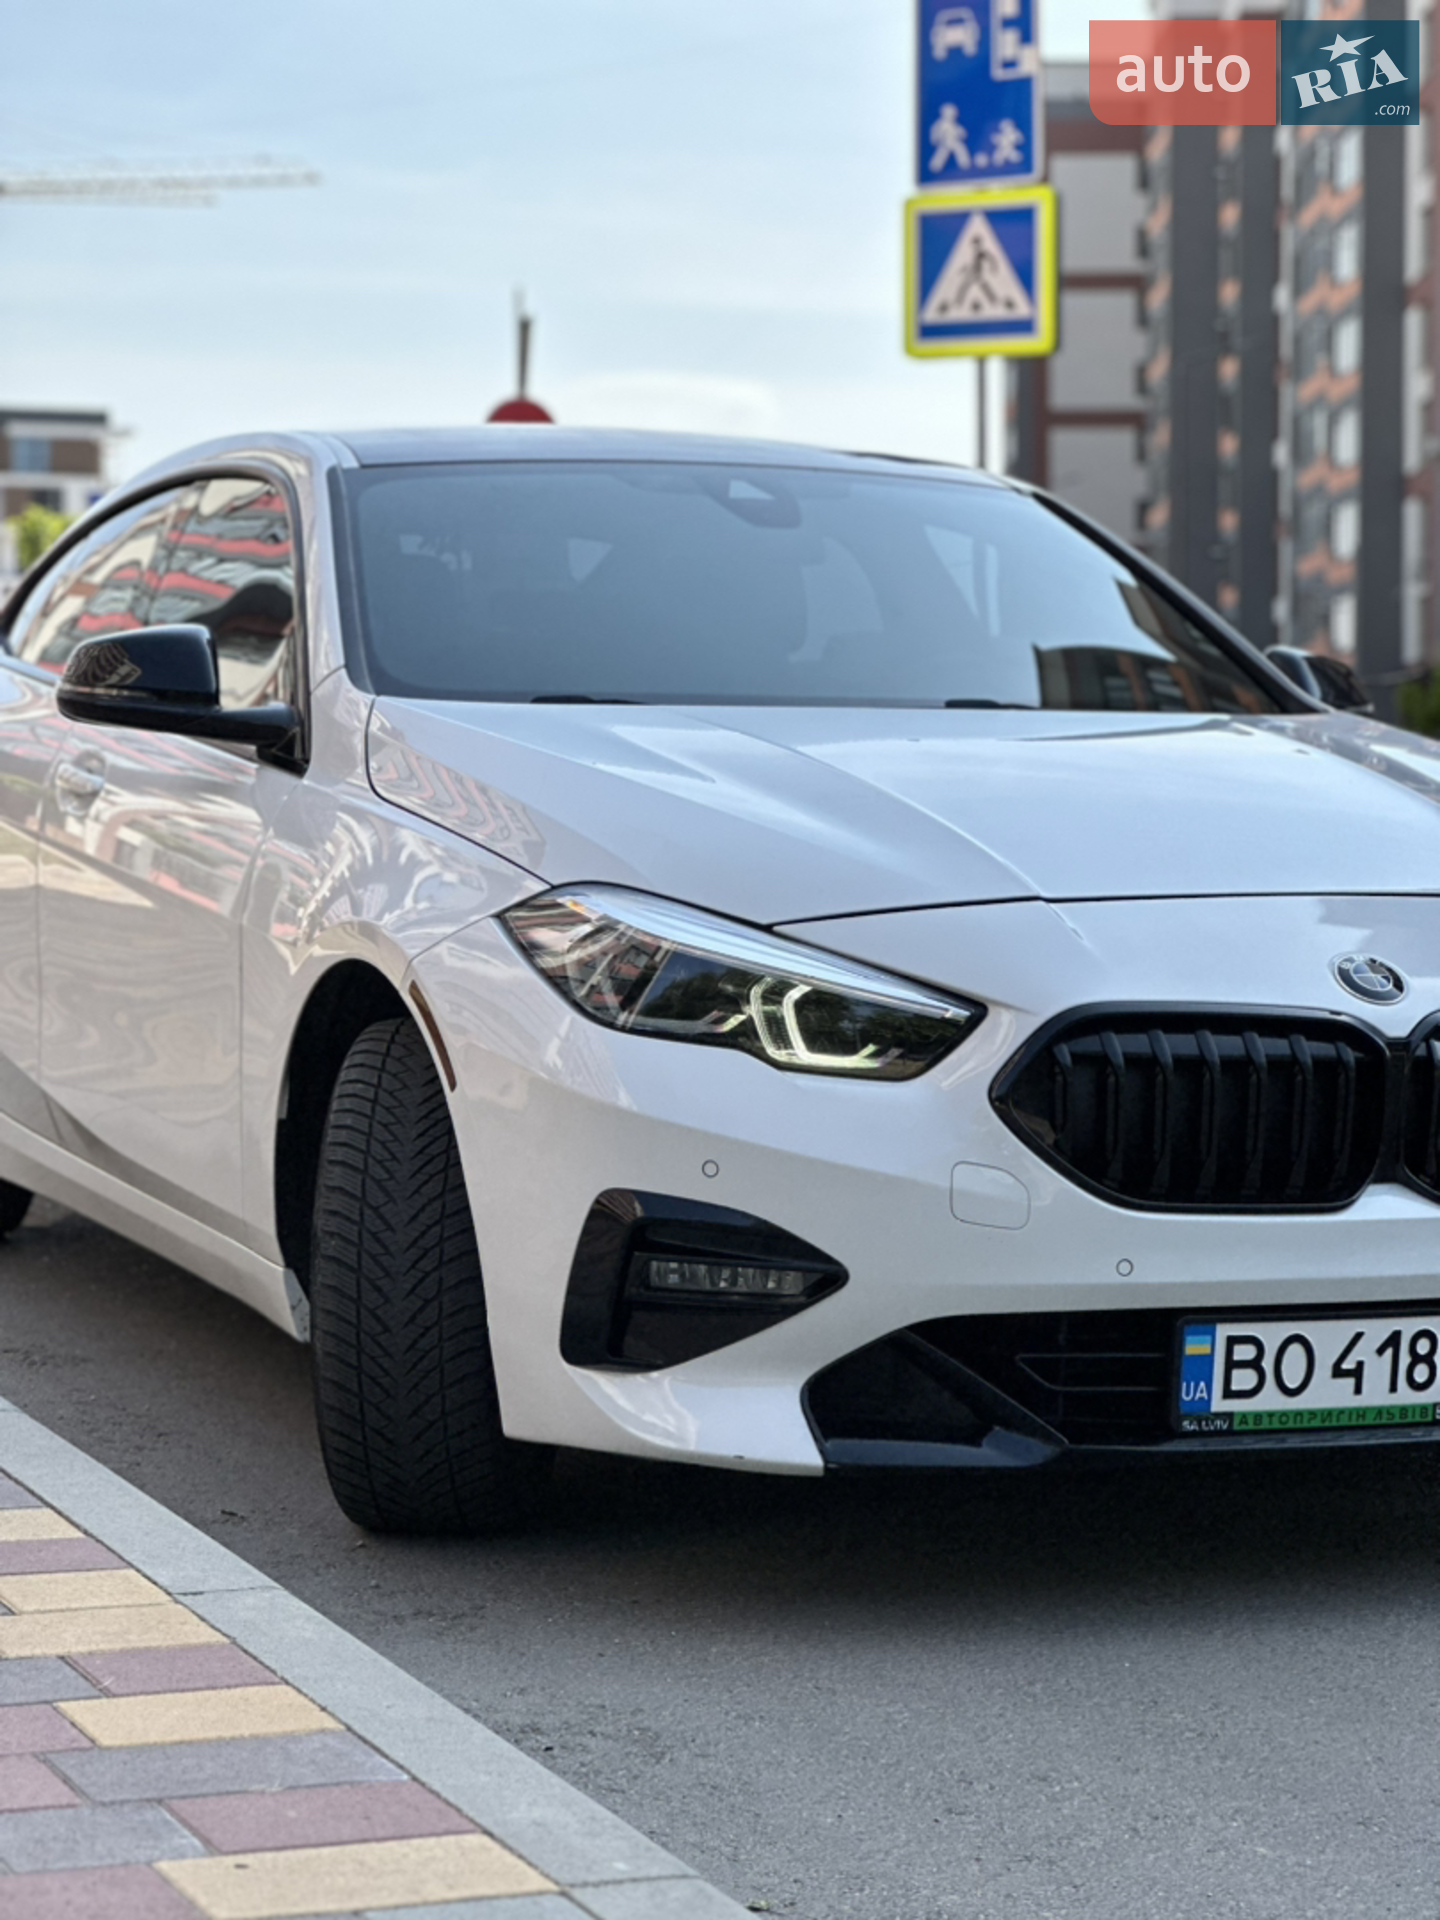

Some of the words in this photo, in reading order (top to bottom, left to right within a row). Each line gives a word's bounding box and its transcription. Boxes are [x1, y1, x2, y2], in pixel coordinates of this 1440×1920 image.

[1222, 1333, 1316, 1400] BO
[1331, 1328, 1439, 1396] 418
[1181, 1381, 1208, 1401] UA
